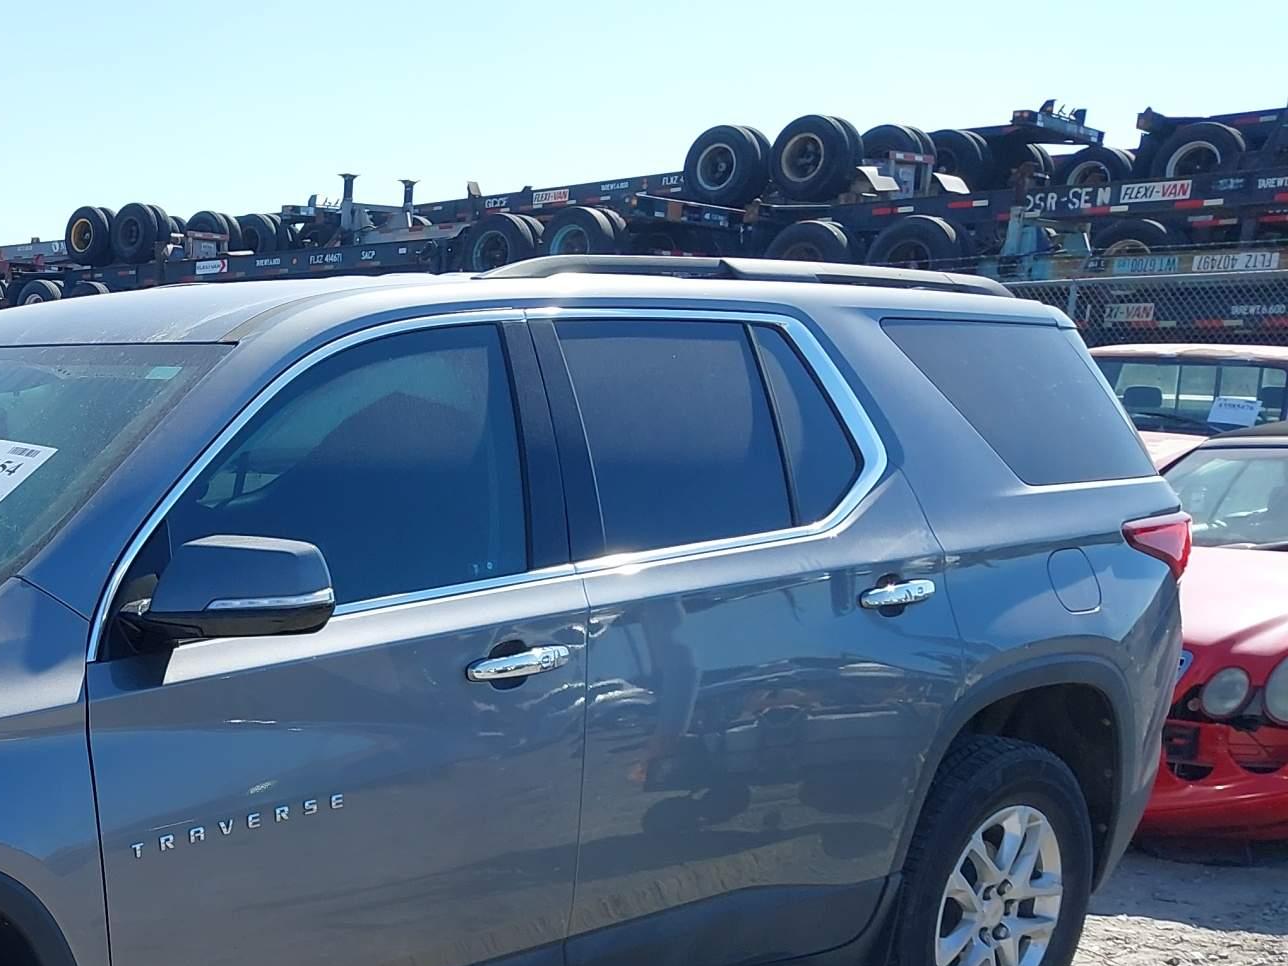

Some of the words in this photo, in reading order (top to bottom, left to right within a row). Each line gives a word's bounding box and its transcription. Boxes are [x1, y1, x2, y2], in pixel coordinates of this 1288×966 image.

[533, 190, 569, 204] FLEXI-VAN
[1122, 183, 1190, 201] FLEXI-VAN
[130, 793, 345, 859] TRAVERSE
